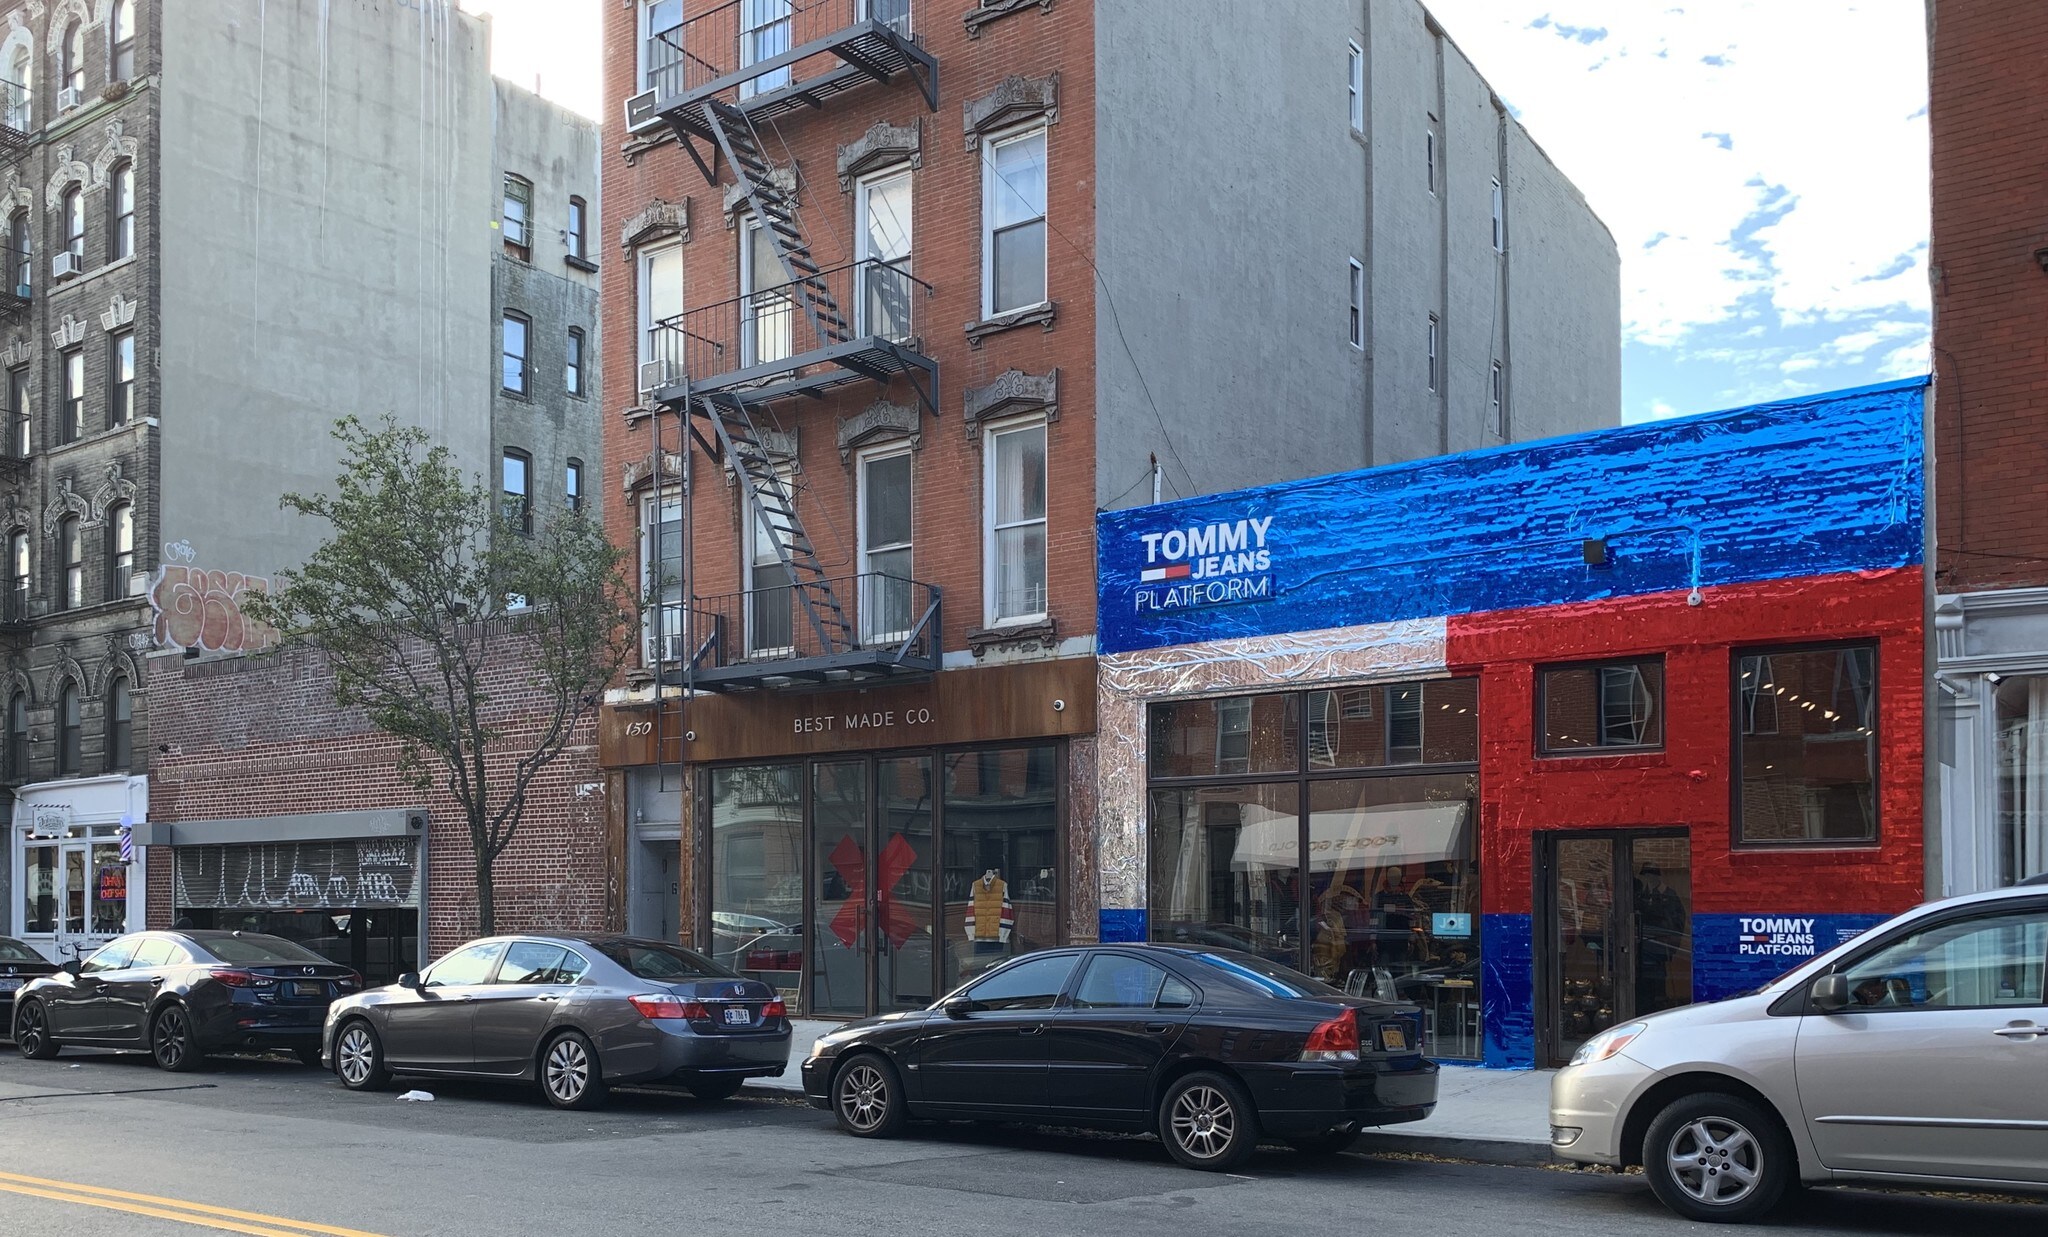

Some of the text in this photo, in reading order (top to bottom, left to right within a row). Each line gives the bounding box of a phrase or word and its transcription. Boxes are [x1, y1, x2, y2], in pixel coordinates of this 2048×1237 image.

[1141, 516, 1273, 563] TOMMY
[1192, 550, 1271, 579] JEANS
[1134, 576, 1267, 612] PLATFORM
[625, 721, 652, 737] 150
[794, 708, 935, 733] BEST MADE CO.
[1739, 918, 1815, 933] TOMMY
[1768, 933, 1815, 944] JEANS
[1739, 944, 1815, 956] PLATFORM
